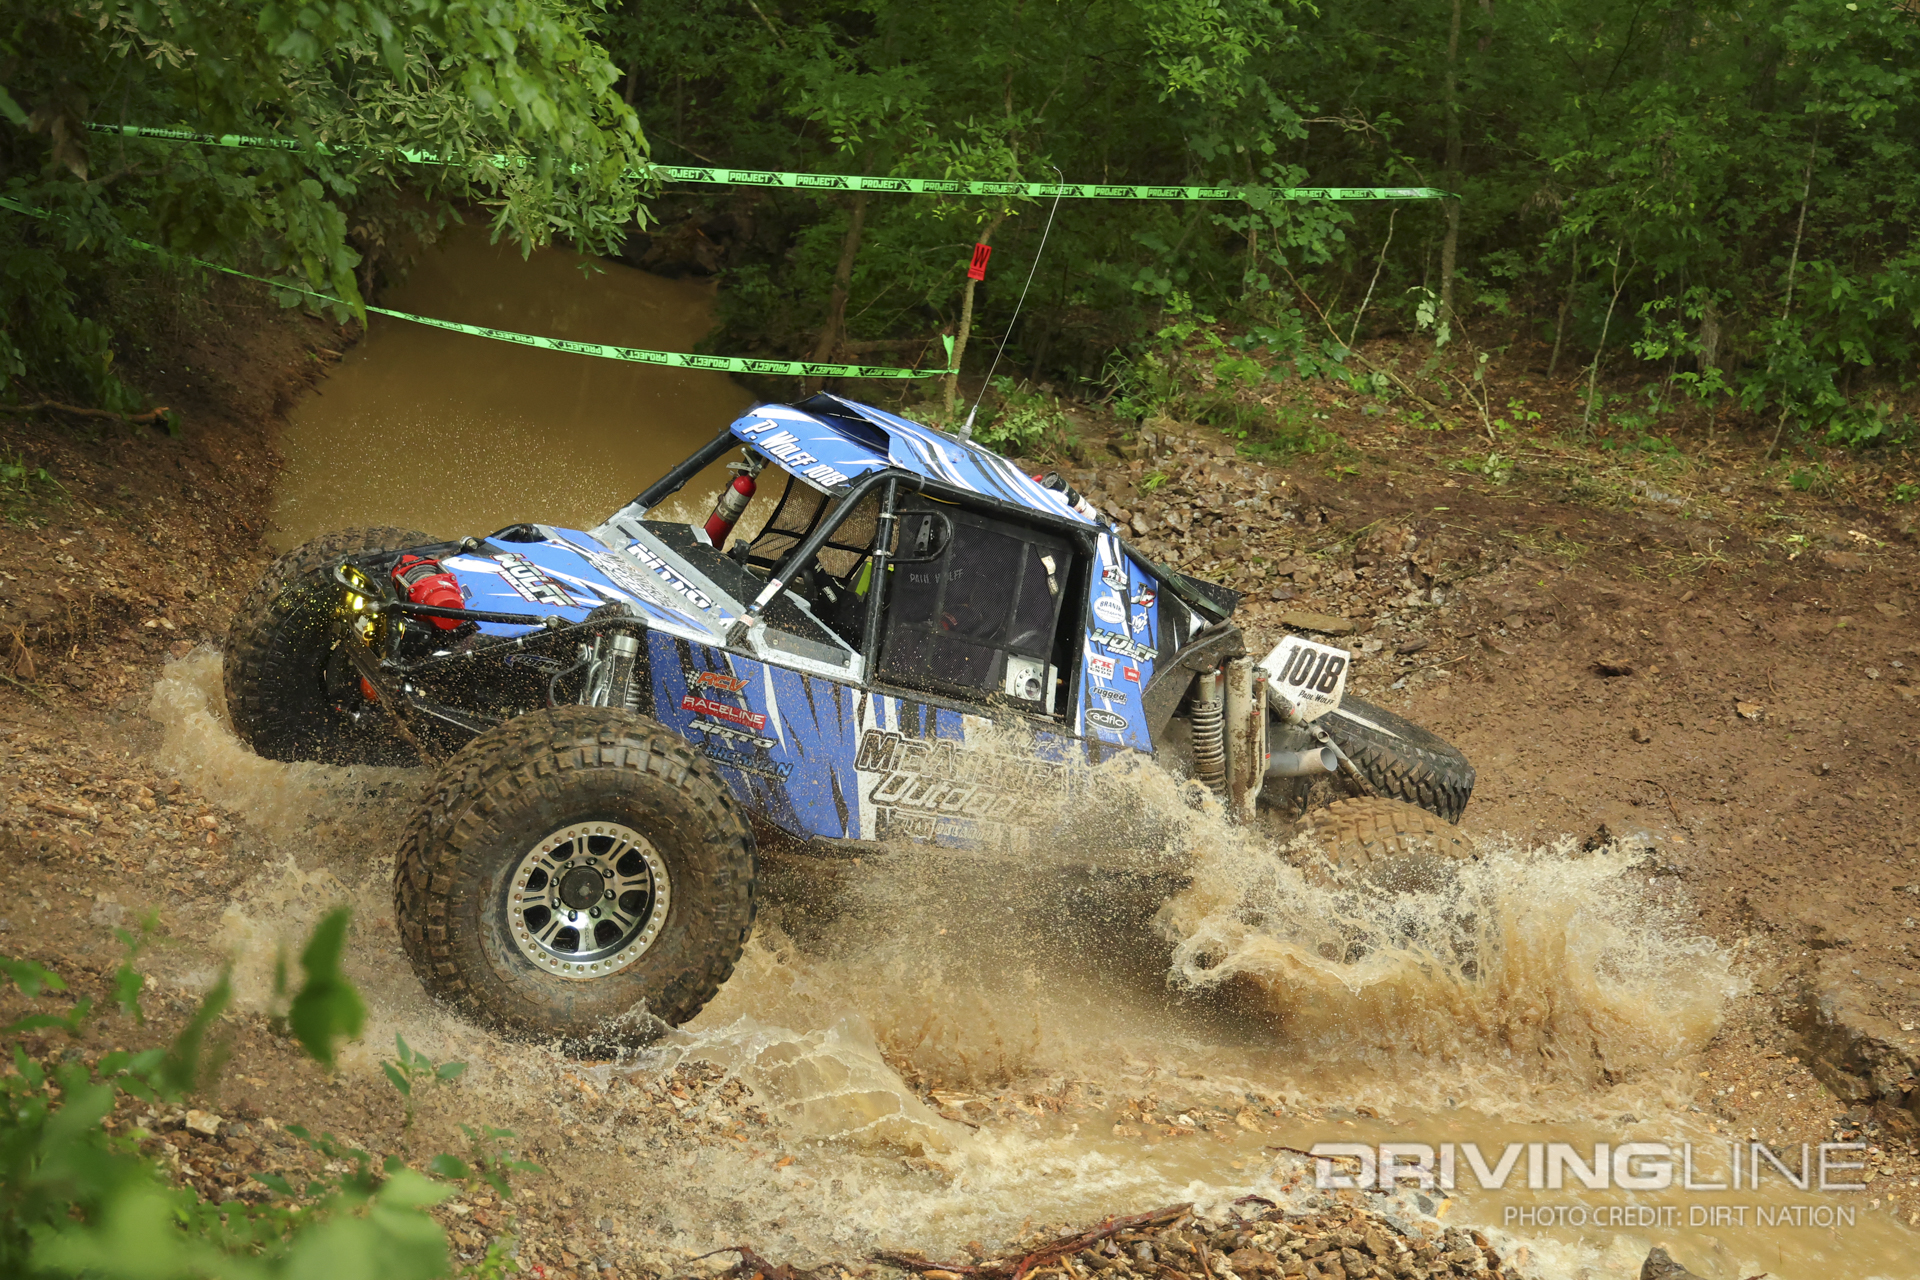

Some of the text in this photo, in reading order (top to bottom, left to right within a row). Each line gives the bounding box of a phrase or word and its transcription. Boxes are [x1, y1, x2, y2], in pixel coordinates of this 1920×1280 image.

[667, 167, 701, 180] OJECT
[728, 171, 770, 183] PROJECT
[796, 176, 835, 187] PROJECT
[861, 178, 900, 190] PROJECT
[923, 181, 959, 192] PROJECT
[1040, 184, 1073, 195] PROJECT
[1095, 186, 1127, 197] PROJECT
[1148, 187, 1179, 198] PROJECT
[629, 350, 668, 363] PROJECT
[692, 356, 730, 369] PROJECT
[753, 362, 790, 373] PROJECT
[741, 419, 850, 488] P. WOLFF 1018
[935, 568, 964, 586] WLFF
[1090, 628, 1159, 661] WOLFF
[1276, 644, 1346, 694] 1018
[697, 671, 751, 692] RCV
[1297, 689, 1337, 706] PAUL WOLFF
[682, 696, 765, 725] RACELINE
